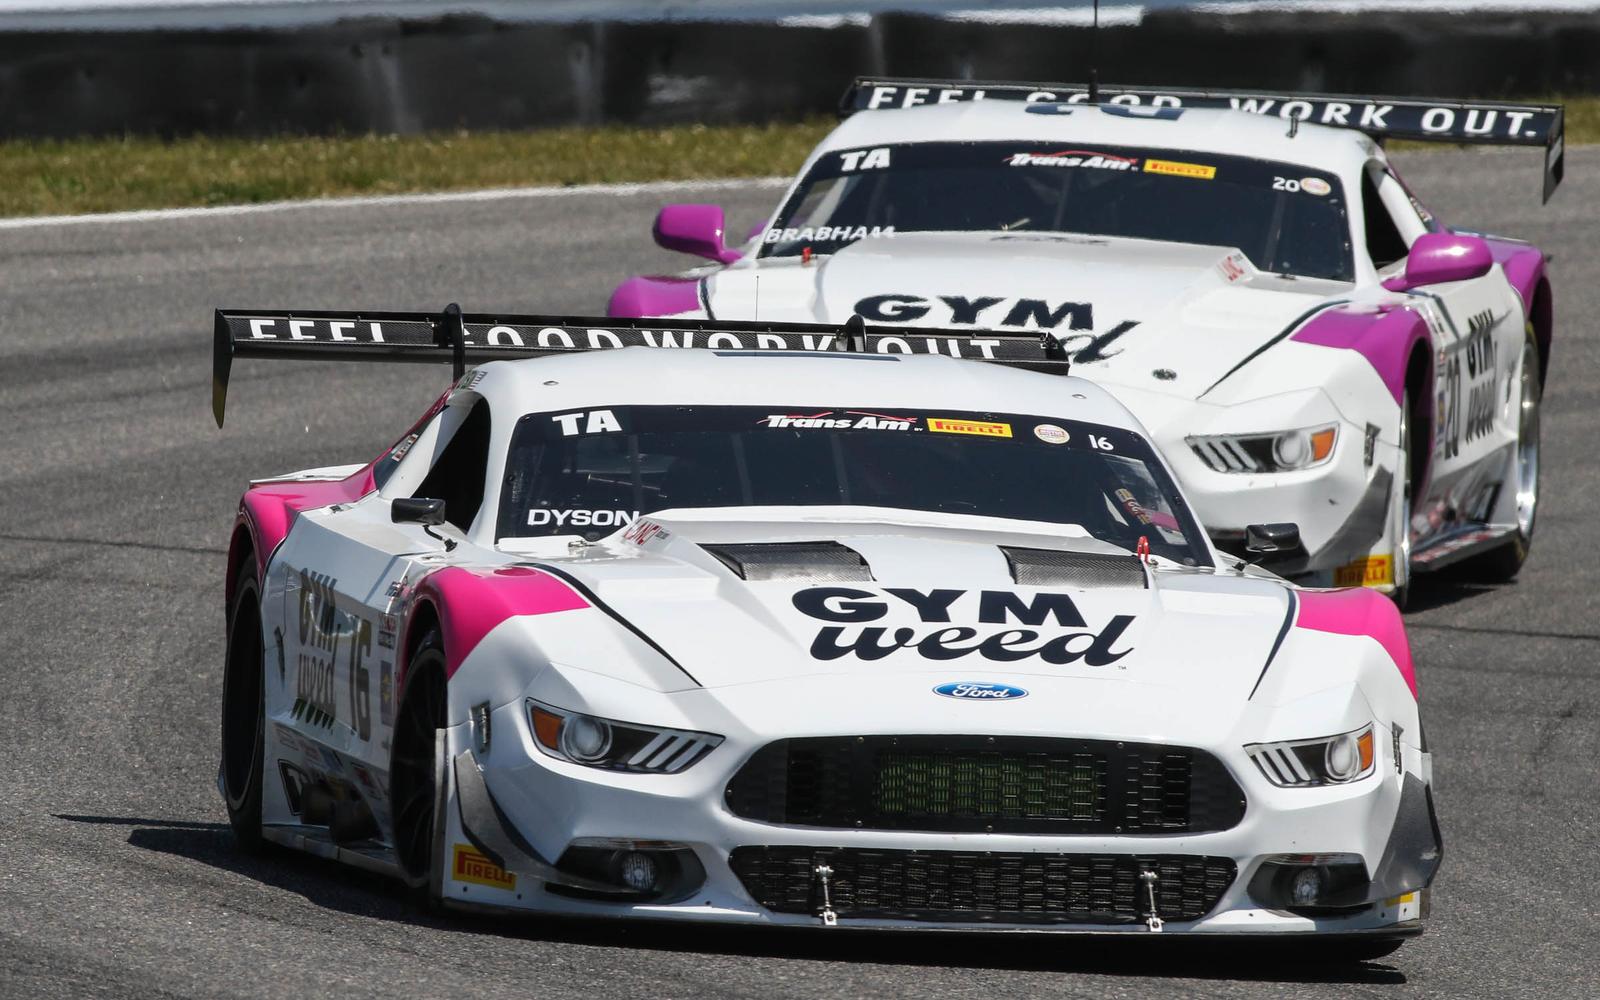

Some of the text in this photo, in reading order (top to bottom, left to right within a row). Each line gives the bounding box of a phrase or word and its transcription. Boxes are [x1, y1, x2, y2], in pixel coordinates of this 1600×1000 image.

[1229, 97, 1394, 128] WORK
[840, 148, 890, 172] TA
[1009, 153, 1131, 170] Trans Am
[1272, 176, 1300, 192] 20
[764, 225, 897, 243] BRABHAM
[853, 294, 1095, 331] GYM
[552, 409, 623, 436] TA
[767, 414, 852, 430] Trans
[860, 416, 911, 432] Am
[934, 420, 1004, 434] PIRELLI
[1088, 434, 1114, 451] 16
[527, 508, 641, 527] DYSON
[791, 586, 1089, 628] GYM
[809, 615, 1137, 667] weed
[349, 613, 372, 742] 16
[951, 681, 1012, 699] Ford
